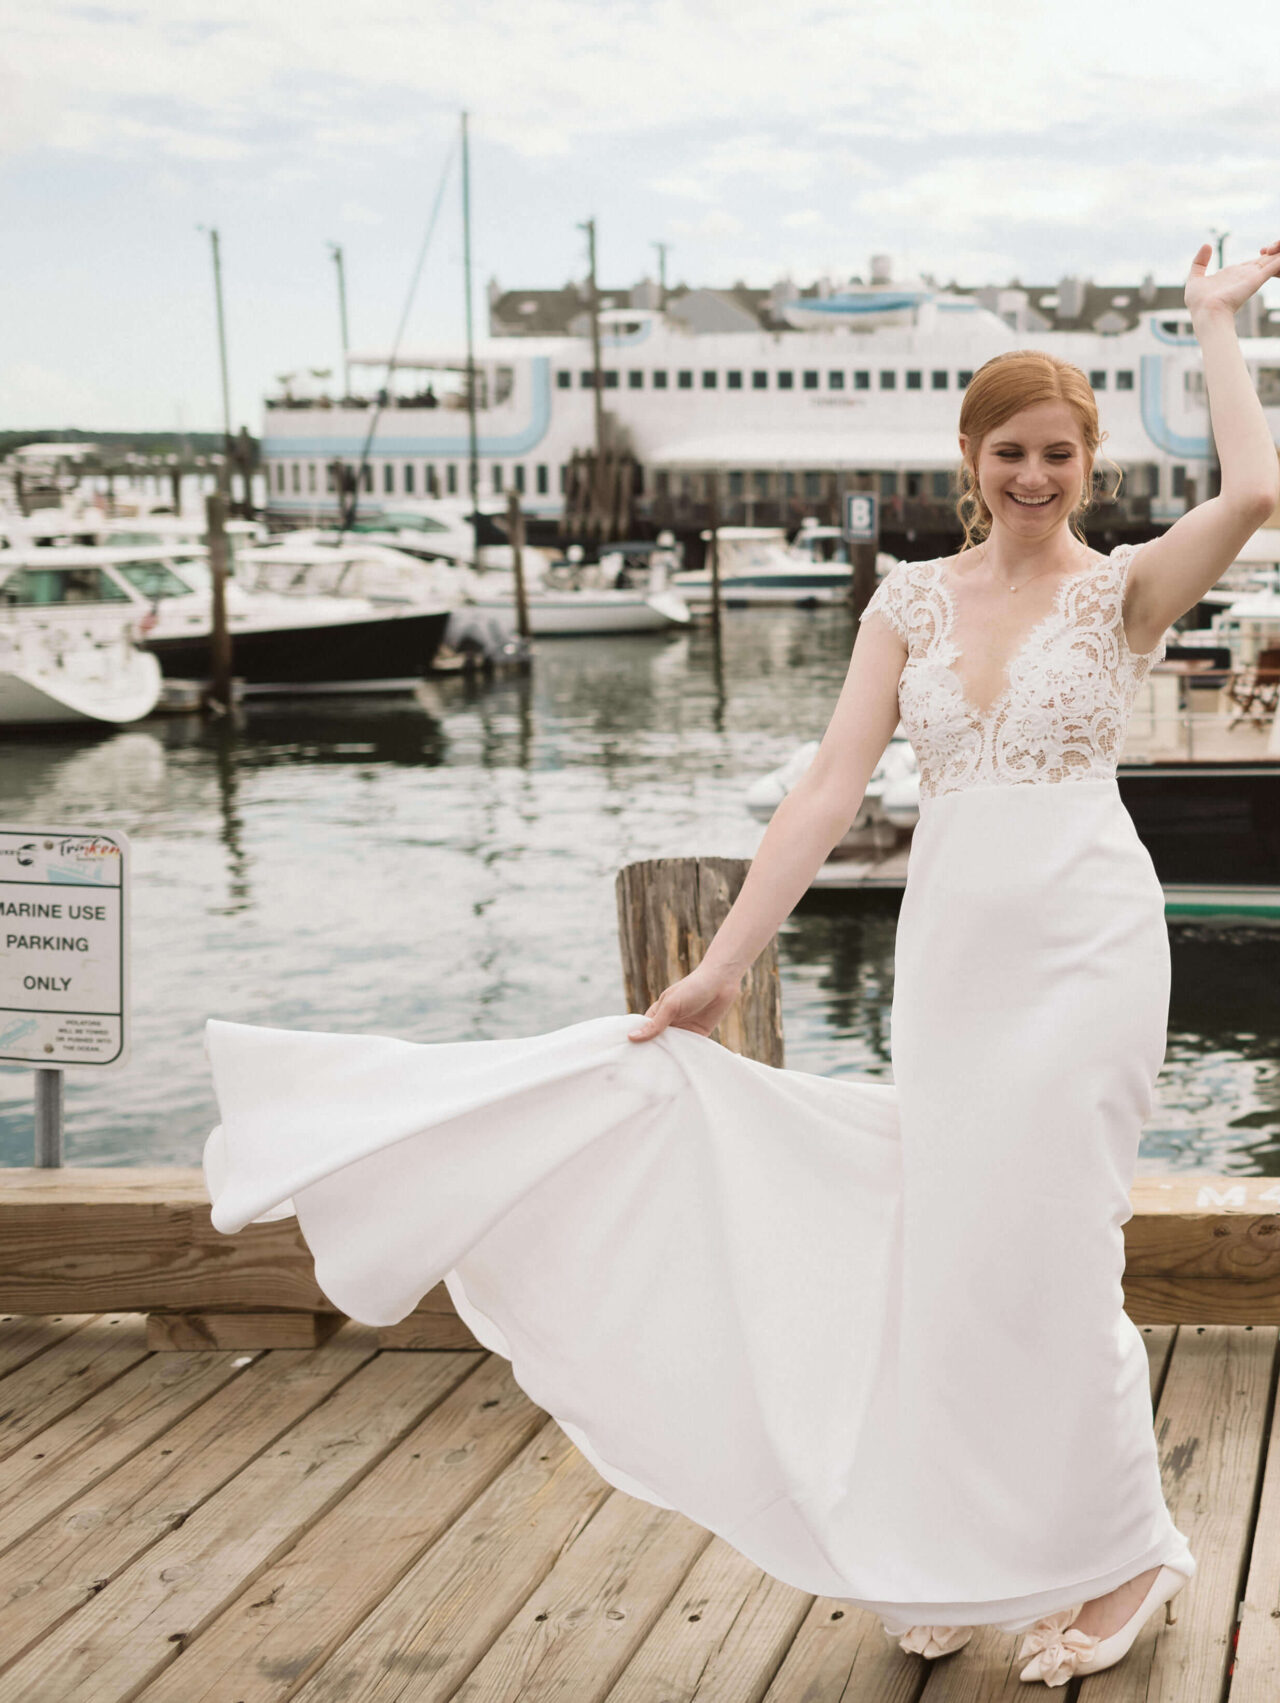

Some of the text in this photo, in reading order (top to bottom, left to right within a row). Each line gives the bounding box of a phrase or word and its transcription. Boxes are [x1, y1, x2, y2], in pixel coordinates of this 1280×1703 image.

[852, 498, 871, 527] B
[69, 905, 107, 921] USE
[6, 934, 89, 952] PARKING
[24, 976, 72, 991] ONLY
